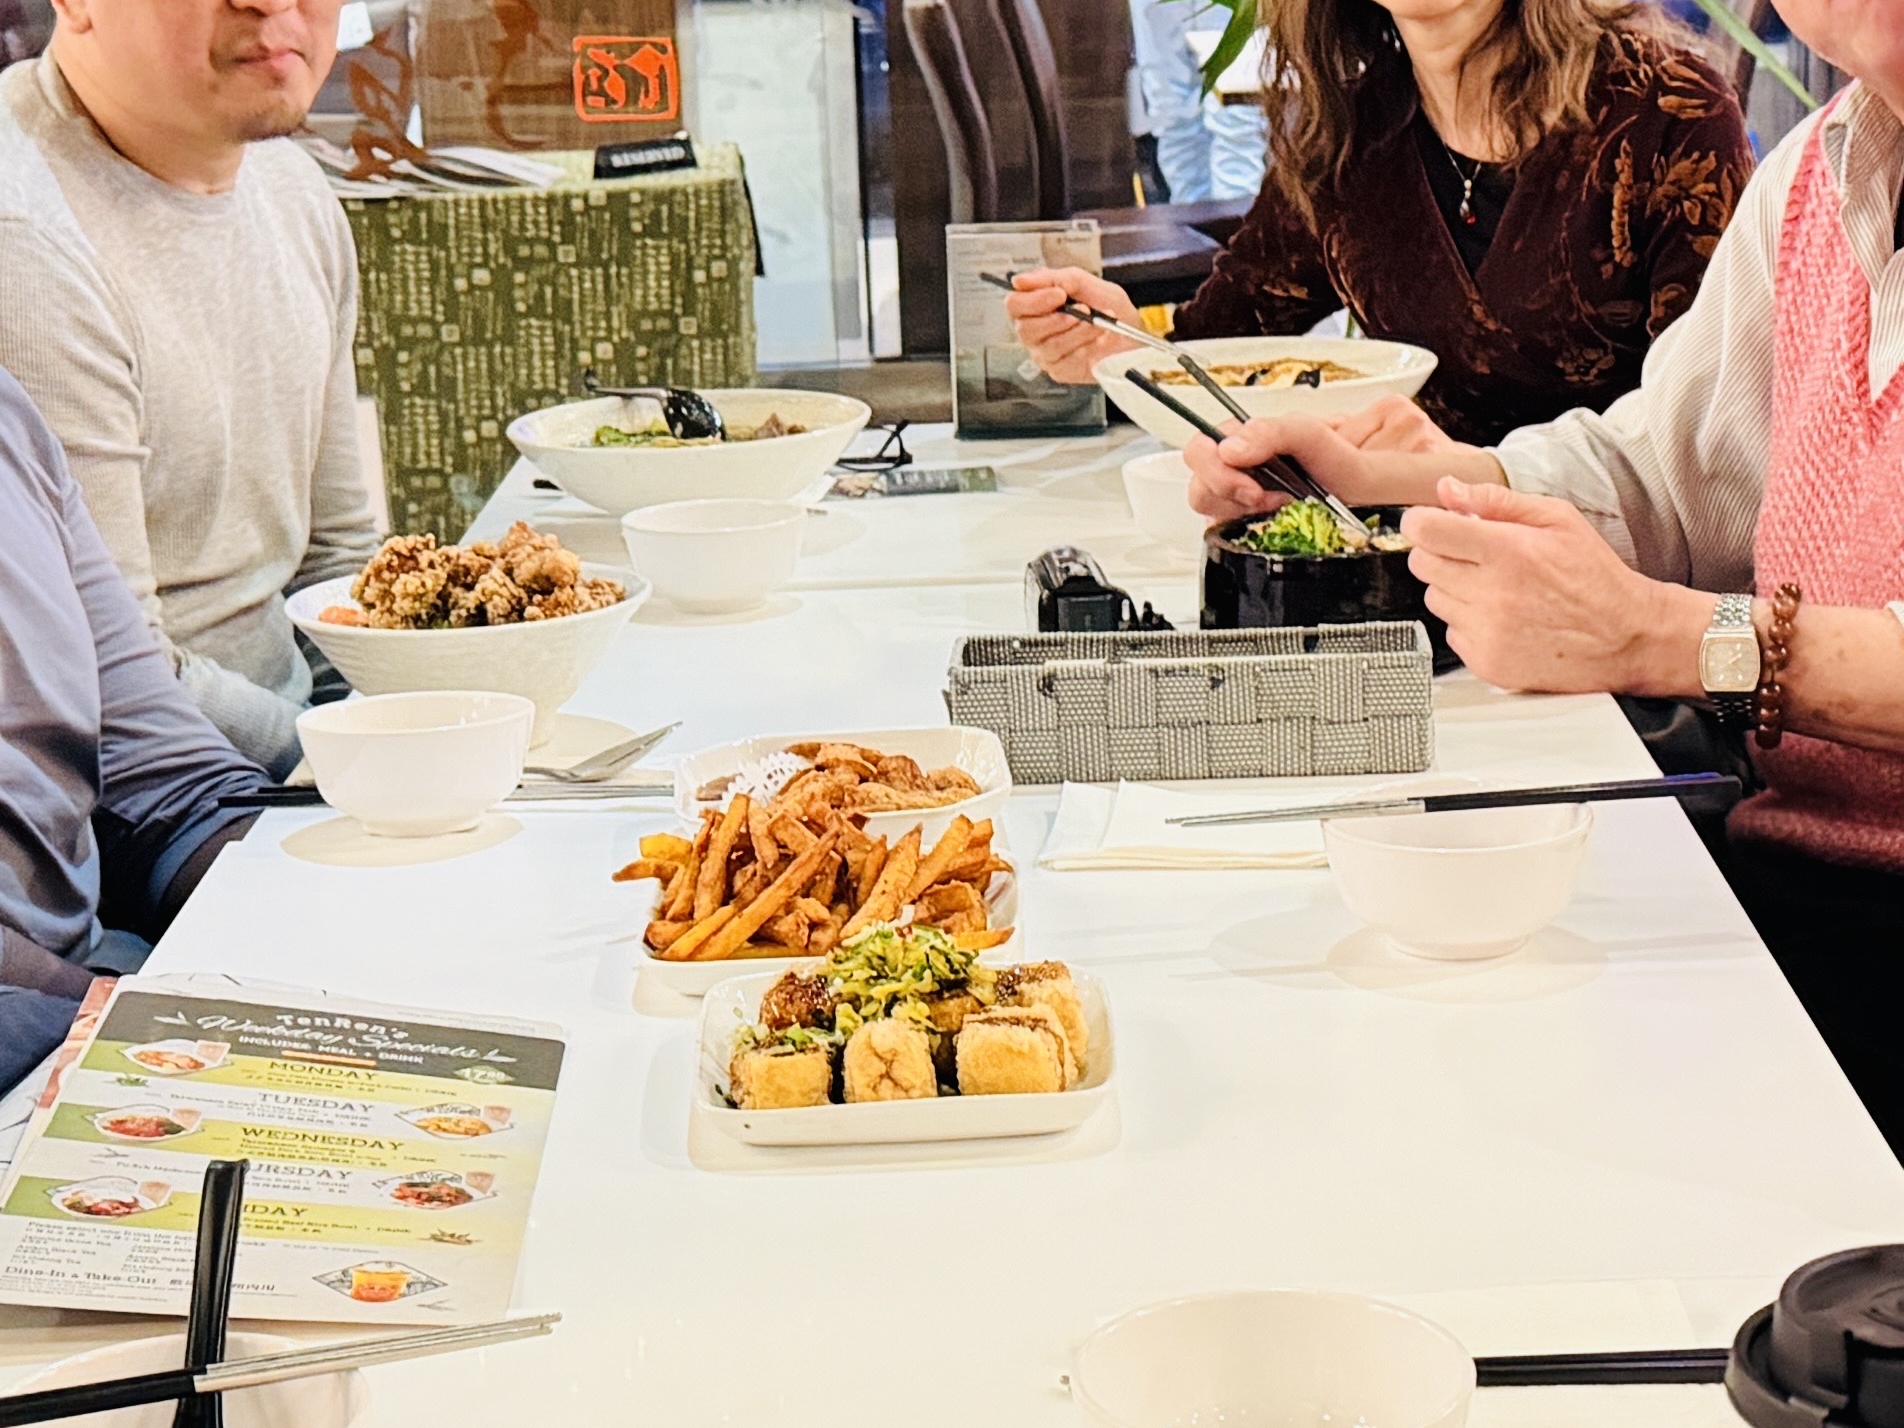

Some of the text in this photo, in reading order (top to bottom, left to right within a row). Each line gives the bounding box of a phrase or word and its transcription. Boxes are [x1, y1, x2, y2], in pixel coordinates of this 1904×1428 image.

[269, 1061, 379, 1081] MONDAY
[257, 1093, 375, 1113] TUESDAY
[239, 1127, 404, 1151] WEDNESDAY
[241, 1203, 308, 1217] IDAY
